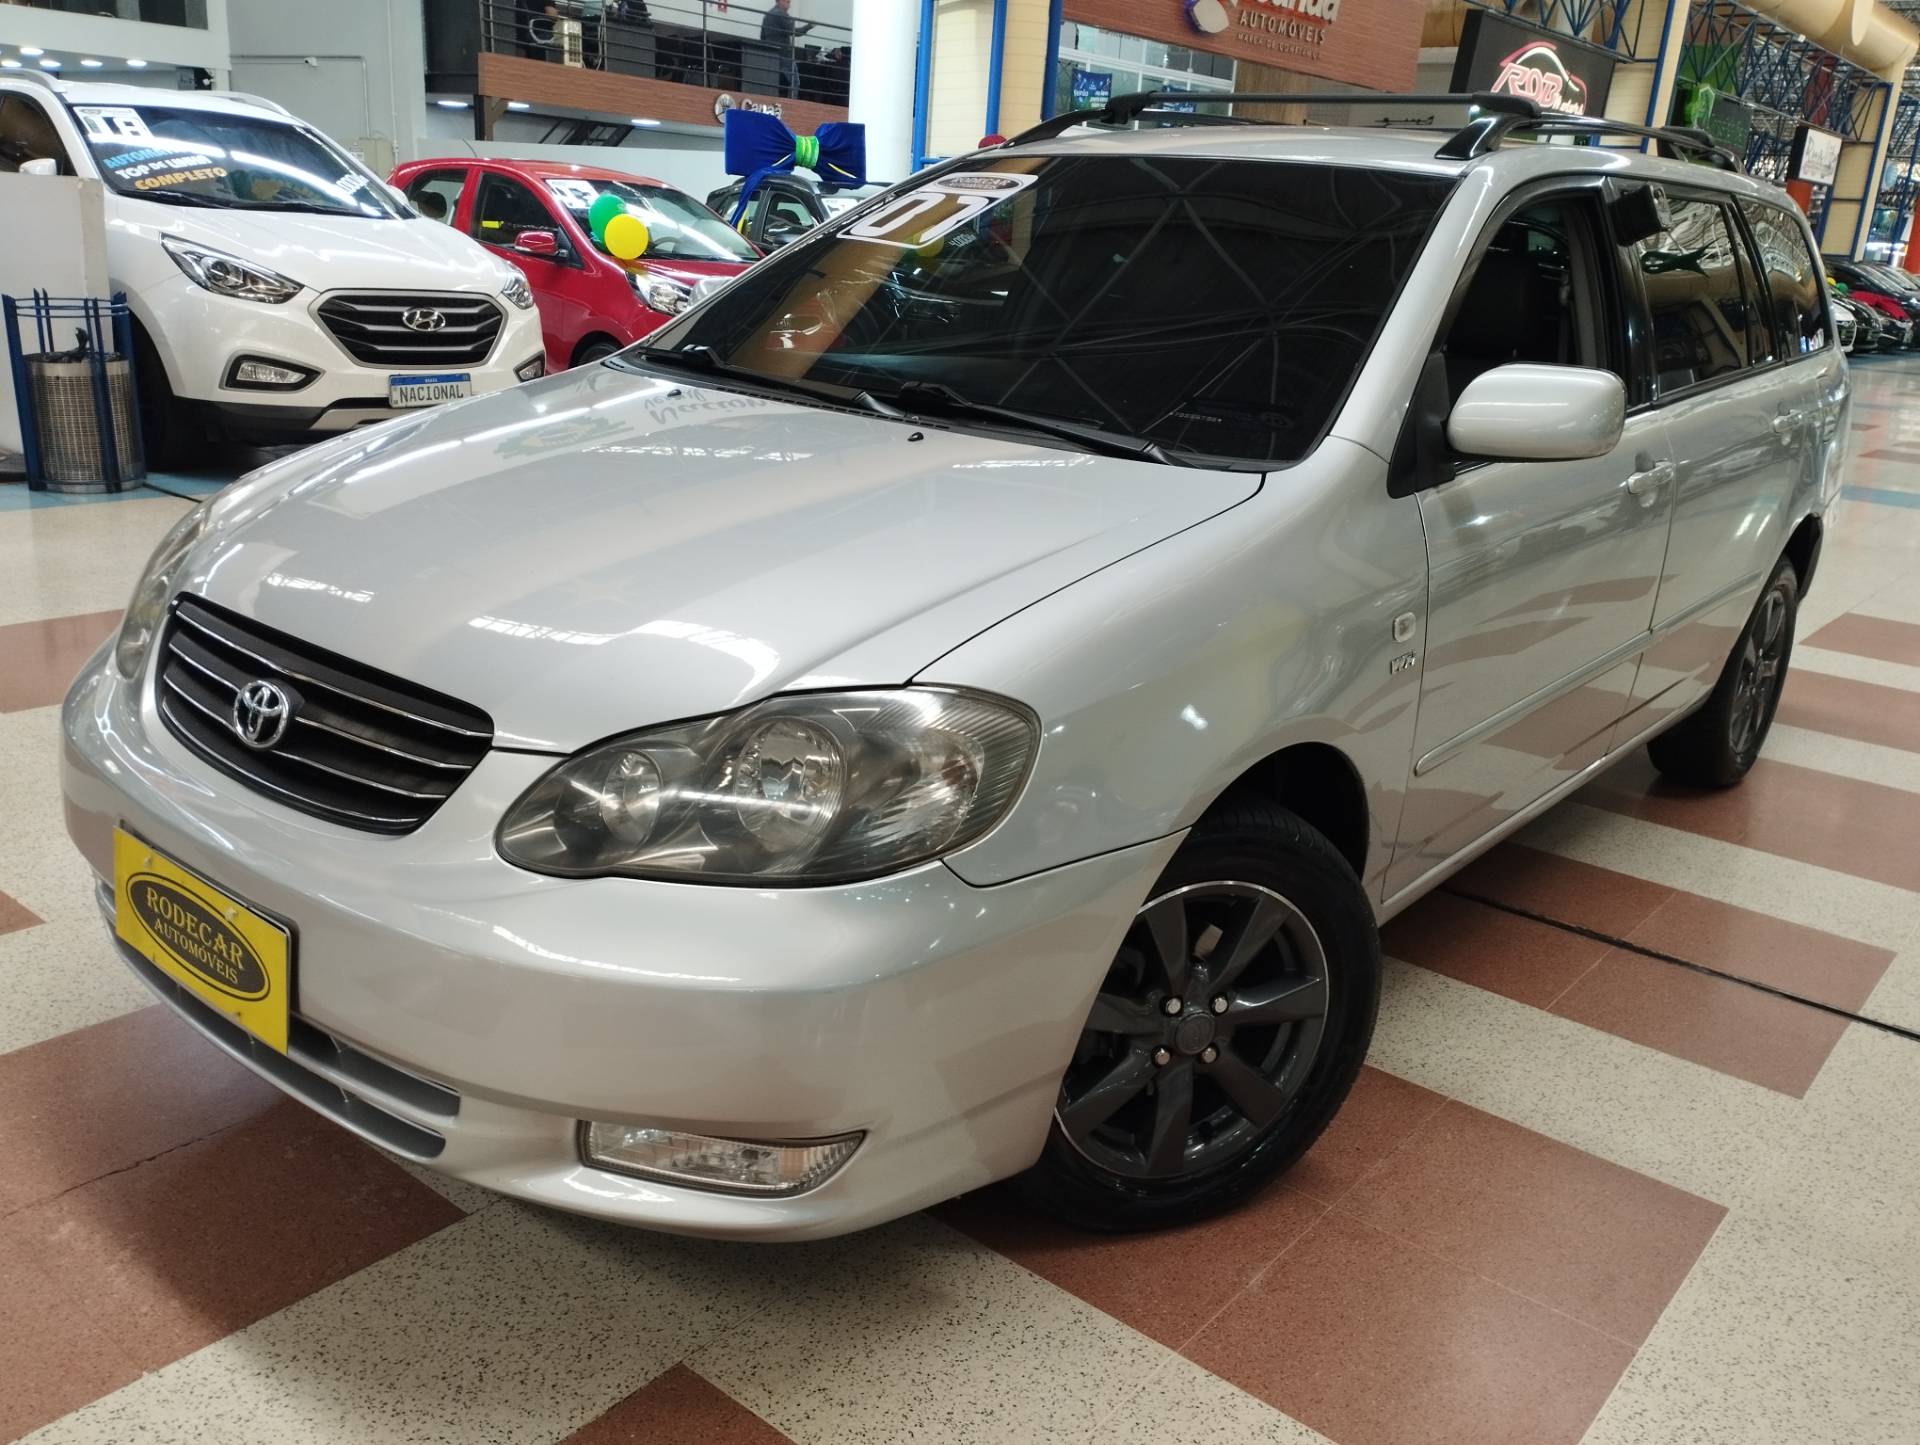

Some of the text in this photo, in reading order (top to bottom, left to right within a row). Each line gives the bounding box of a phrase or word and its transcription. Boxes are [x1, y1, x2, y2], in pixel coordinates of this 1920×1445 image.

[1239, 10, 1325, 44] AUTOMÓVEIS
[115, 163, 150, 179] TOP
[134, 166, 228, 190] COMPLETO
[399, 385, 464, 404] NACIONAL
[146, 887, 245, 970] RODECAR
[154, 918, 239, 985] AUTOMÓVEIS
